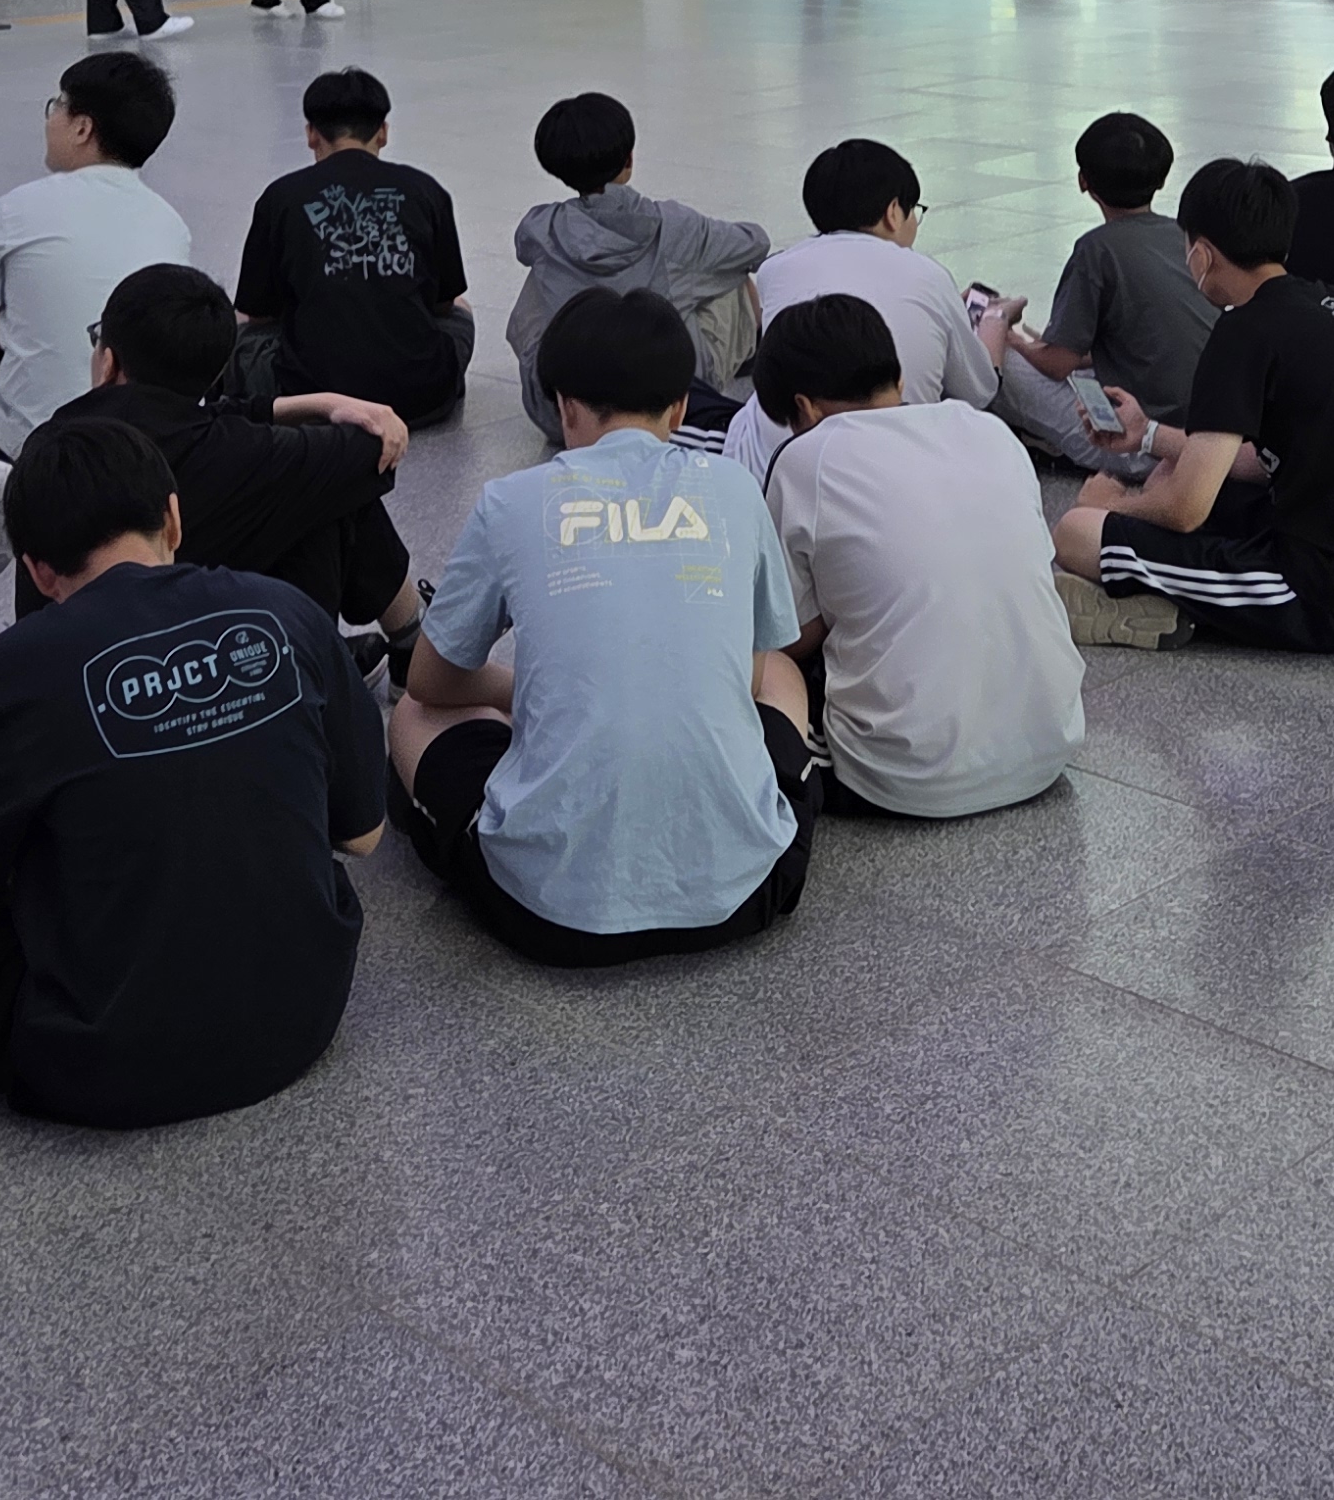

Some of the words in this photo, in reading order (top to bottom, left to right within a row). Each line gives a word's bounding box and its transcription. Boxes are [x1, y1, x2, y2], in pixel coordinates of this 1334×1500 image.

[560, 496, 709, 545] FILA
[229, 641, 268, 662] UNIQUE
[122, 653, 218, 705] PRJCT
[199, 706, 217, 719] THE
